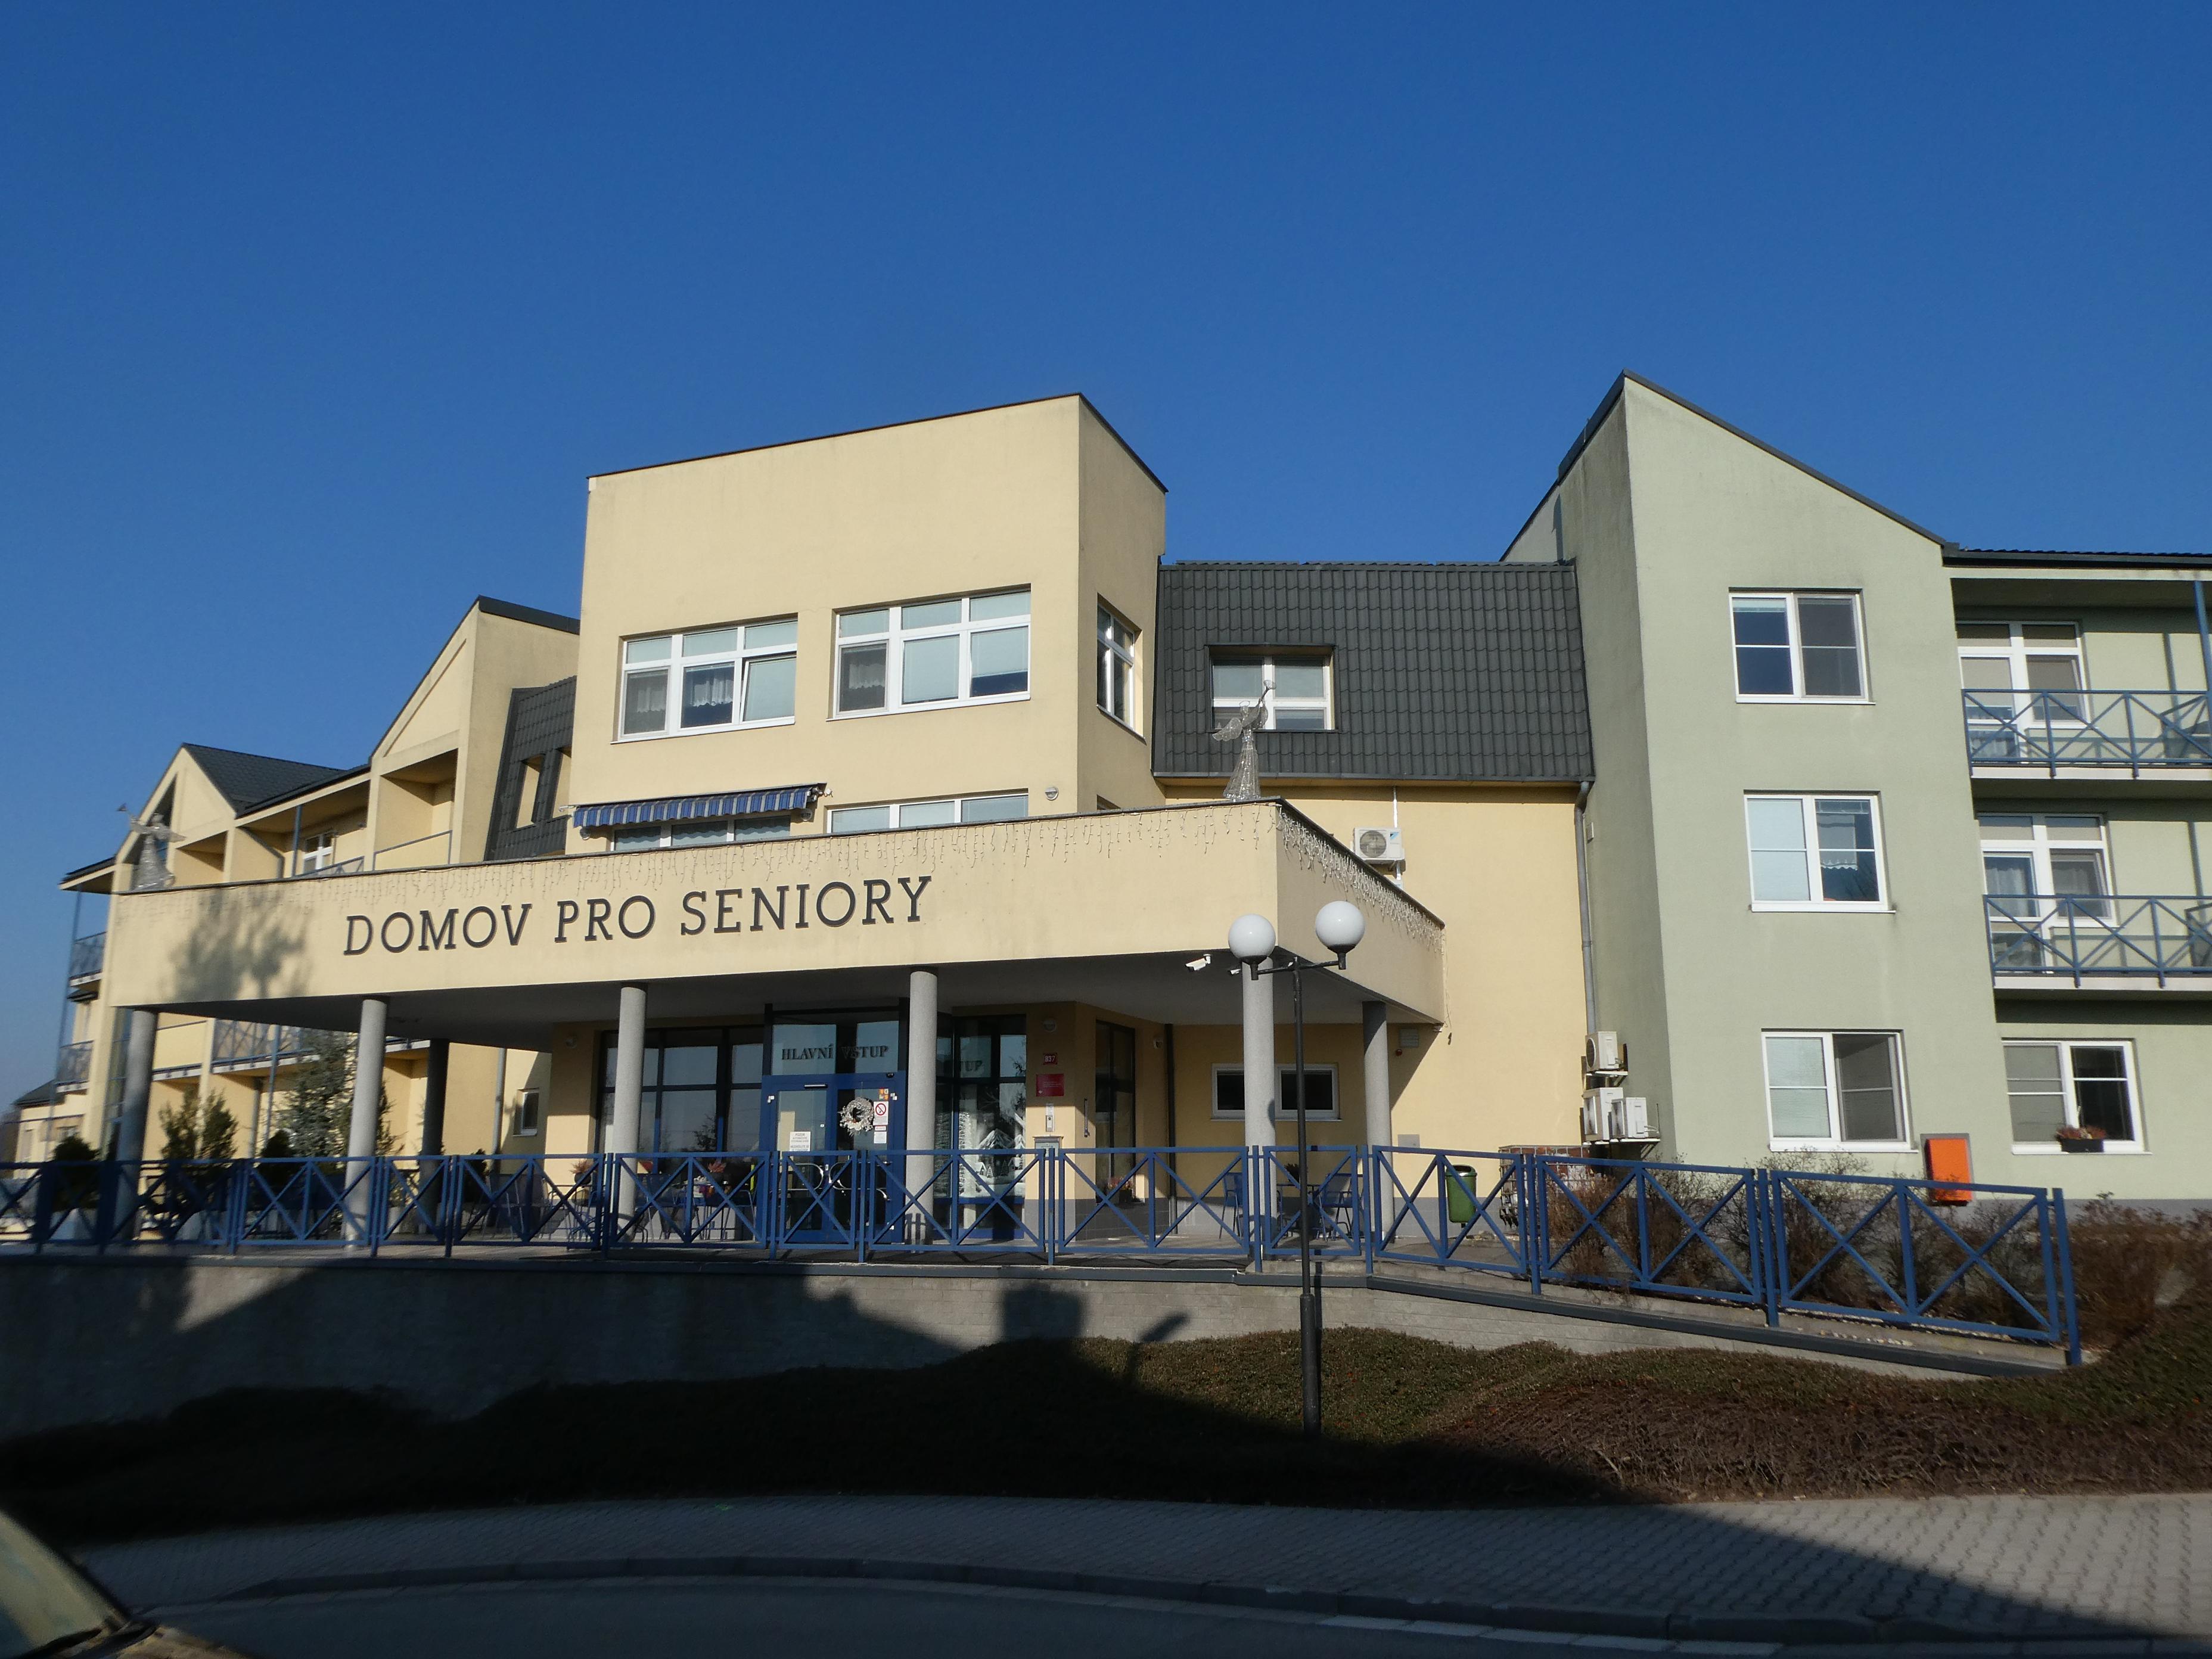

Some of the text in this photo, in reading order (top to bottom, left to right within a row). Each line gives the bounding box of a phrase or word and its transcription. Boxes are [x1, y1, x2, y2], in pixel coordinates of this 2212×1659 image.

[344, 875, 932, 955] DOMOV PRO SENIORY
[782, 1043, 888, 1060] HLAVNÍ VSTUP
